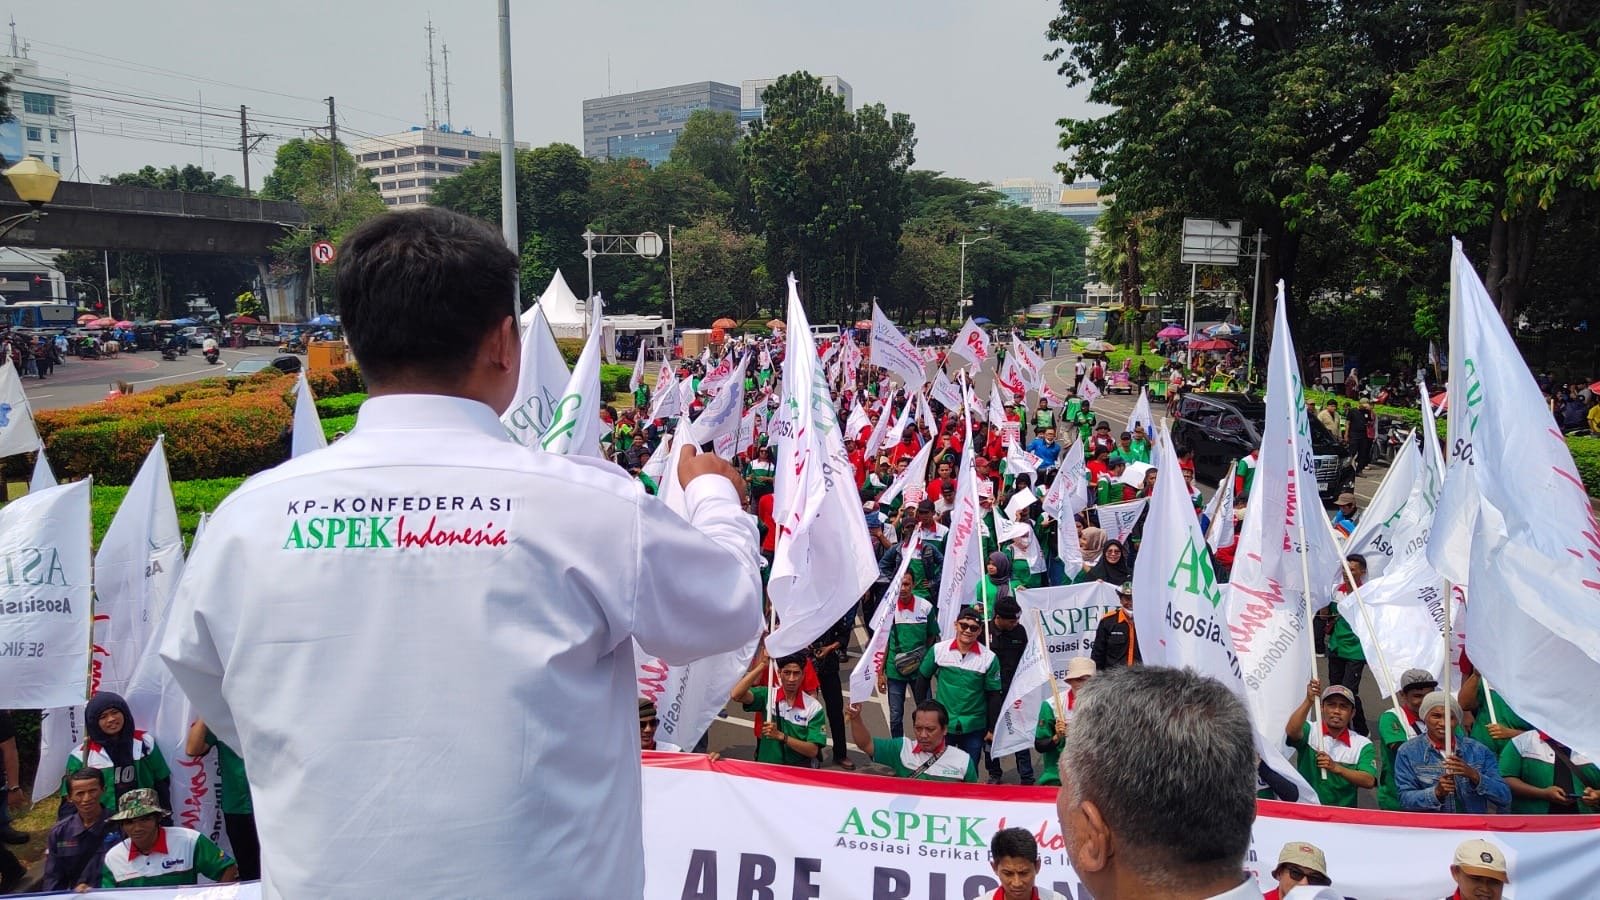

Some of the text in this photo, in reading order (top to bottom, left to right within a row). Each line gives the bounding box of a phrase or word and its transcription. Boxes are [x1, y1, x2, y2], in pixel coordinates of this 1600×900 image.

[287, 496, 511, 515] KP-KONFEDERASI
[283, 515, 508, 550] ASPEK Indonesia
[1039, 604, 1122, 637] ASPE
[836, 806, 988, 847] ASPEK
[835, 836, 910, 856] Asosiasi
[918, 845, 980, 861] Serikat
